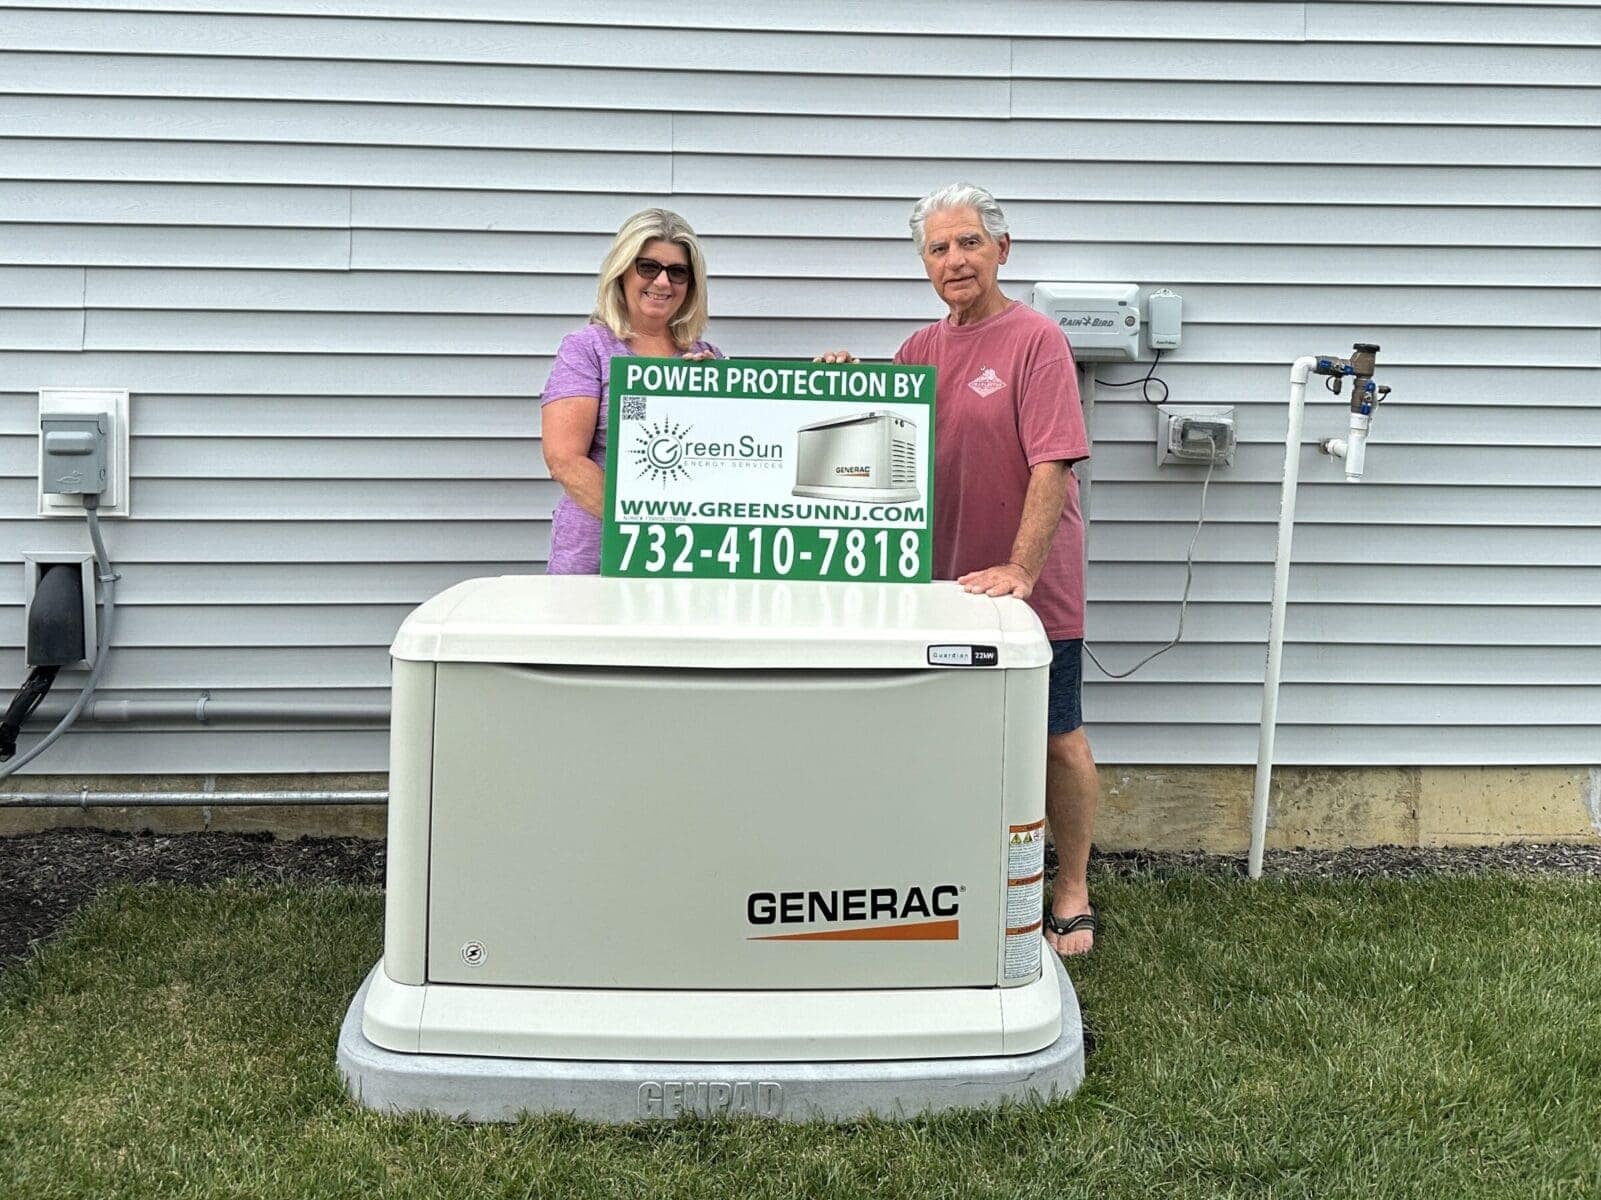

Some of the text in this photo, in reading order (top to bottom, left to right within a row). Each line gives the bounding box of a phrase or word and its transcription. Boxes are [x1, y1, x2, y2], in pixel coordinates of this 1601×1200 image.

[627, 365, 926, 398] POWER PROTECTION BY
[684, 460, 783, 469] ENERGY SERVICES
[835, 466, 871, 474] GENERAC
[621, 500, 925, 522] WWW.GREENSUNNJ.COM
[619, 525, 920, 578] 732-410-7818
[747, 885, 960, 925] GENERAC
[637, 1081, 783, 1119] GENPAD
